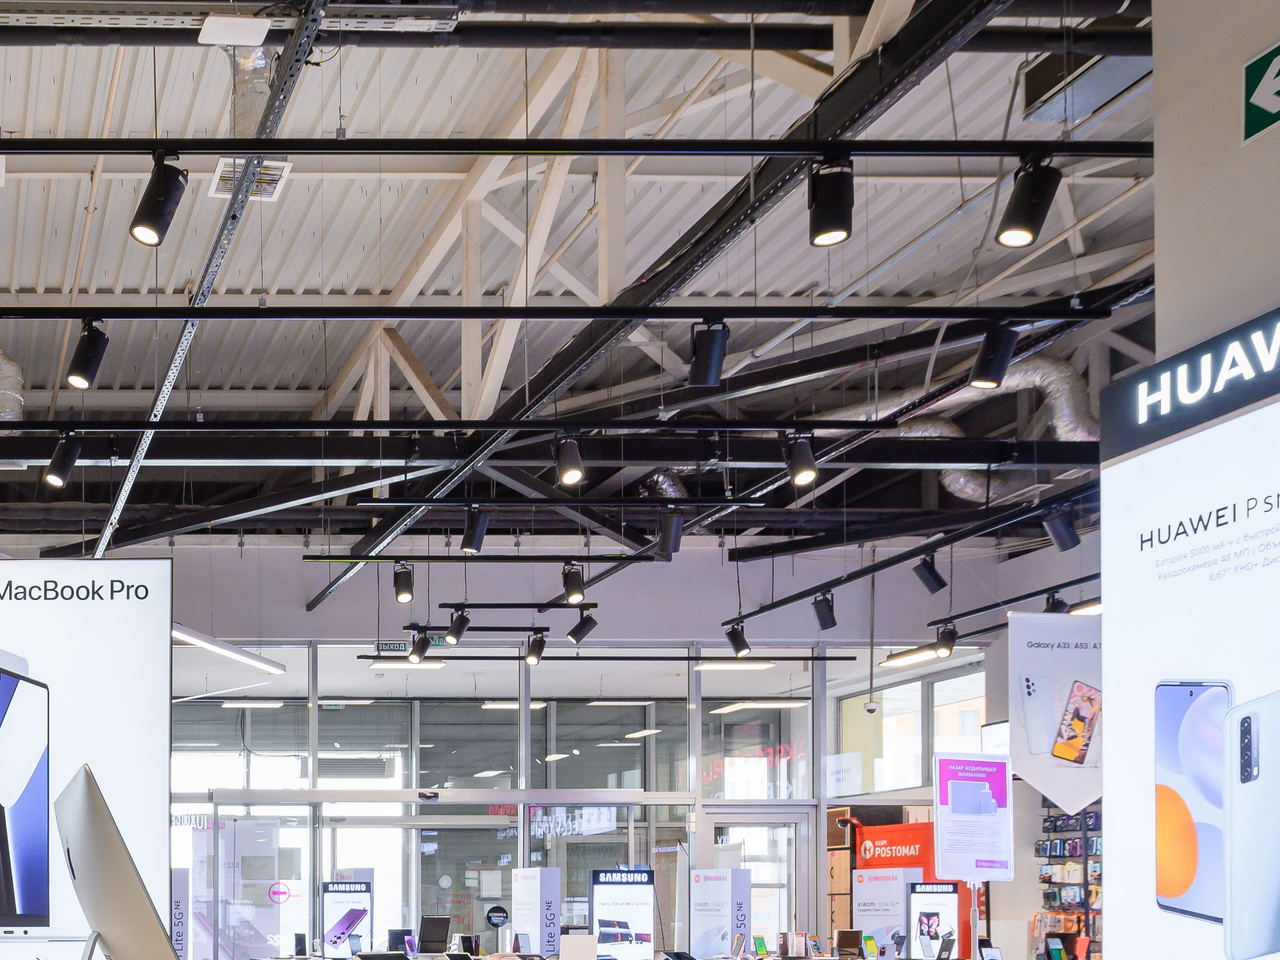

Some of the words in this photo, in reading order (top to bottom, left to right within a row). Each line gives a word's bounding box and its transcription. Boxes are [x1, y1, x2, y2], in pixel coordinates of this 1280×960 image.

[1140, 503, 1236, 551] HUAWEI
[1246, 497, 1258, 518] P
[1263, 493, 1280, 513] s
[1190, 545, 1210, 558] 5000
[110, 580, 149, 600] Pro
[1026, 641, 1054, 650] Galaxy
[1074, 642, 1088, 650] A53
[875, 845, 920, 858] POSTOMAT
[599, 873, 648, 882] SAMSUNG
[328, 883, 366, 891] SAMSUNG
[915, 884, 954, 892] SAMSUNG
[174, 900, 180, 909] NE
[546, 900, 552, 911] NE
[737, 901, 743, 912] NE
[174, 912, 183, 927] 5G
[546, 913, 555, 928] 5G
[737, 914, 746, 929] 5G
[174, 931, 183, 951] Lite
[546, 932, 555, 952] Lite
